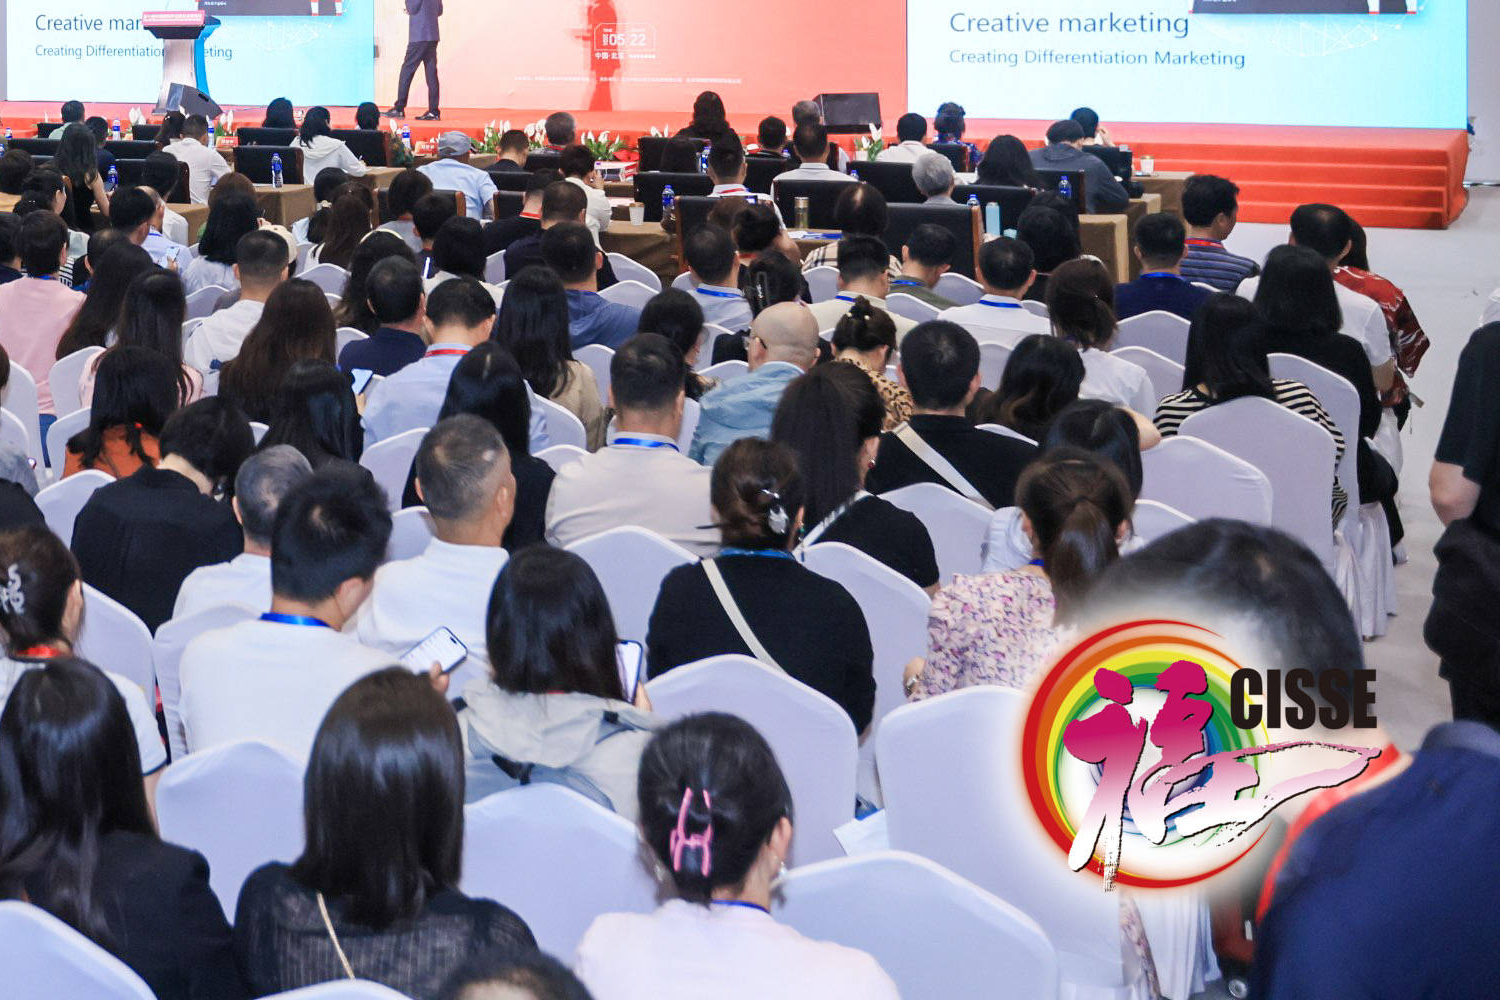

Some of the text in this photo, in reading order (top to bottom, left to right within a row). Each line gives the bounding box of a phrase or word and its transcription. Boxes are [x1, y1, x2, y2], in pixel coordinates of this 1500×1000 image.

[35, 14, 103, 31] Creative
[950, 12, 1189, 38] Creative marketing
[35, 45, 82, 60] Creating
[949, 49, 1246, 69] Creating Differentiation Marketing
